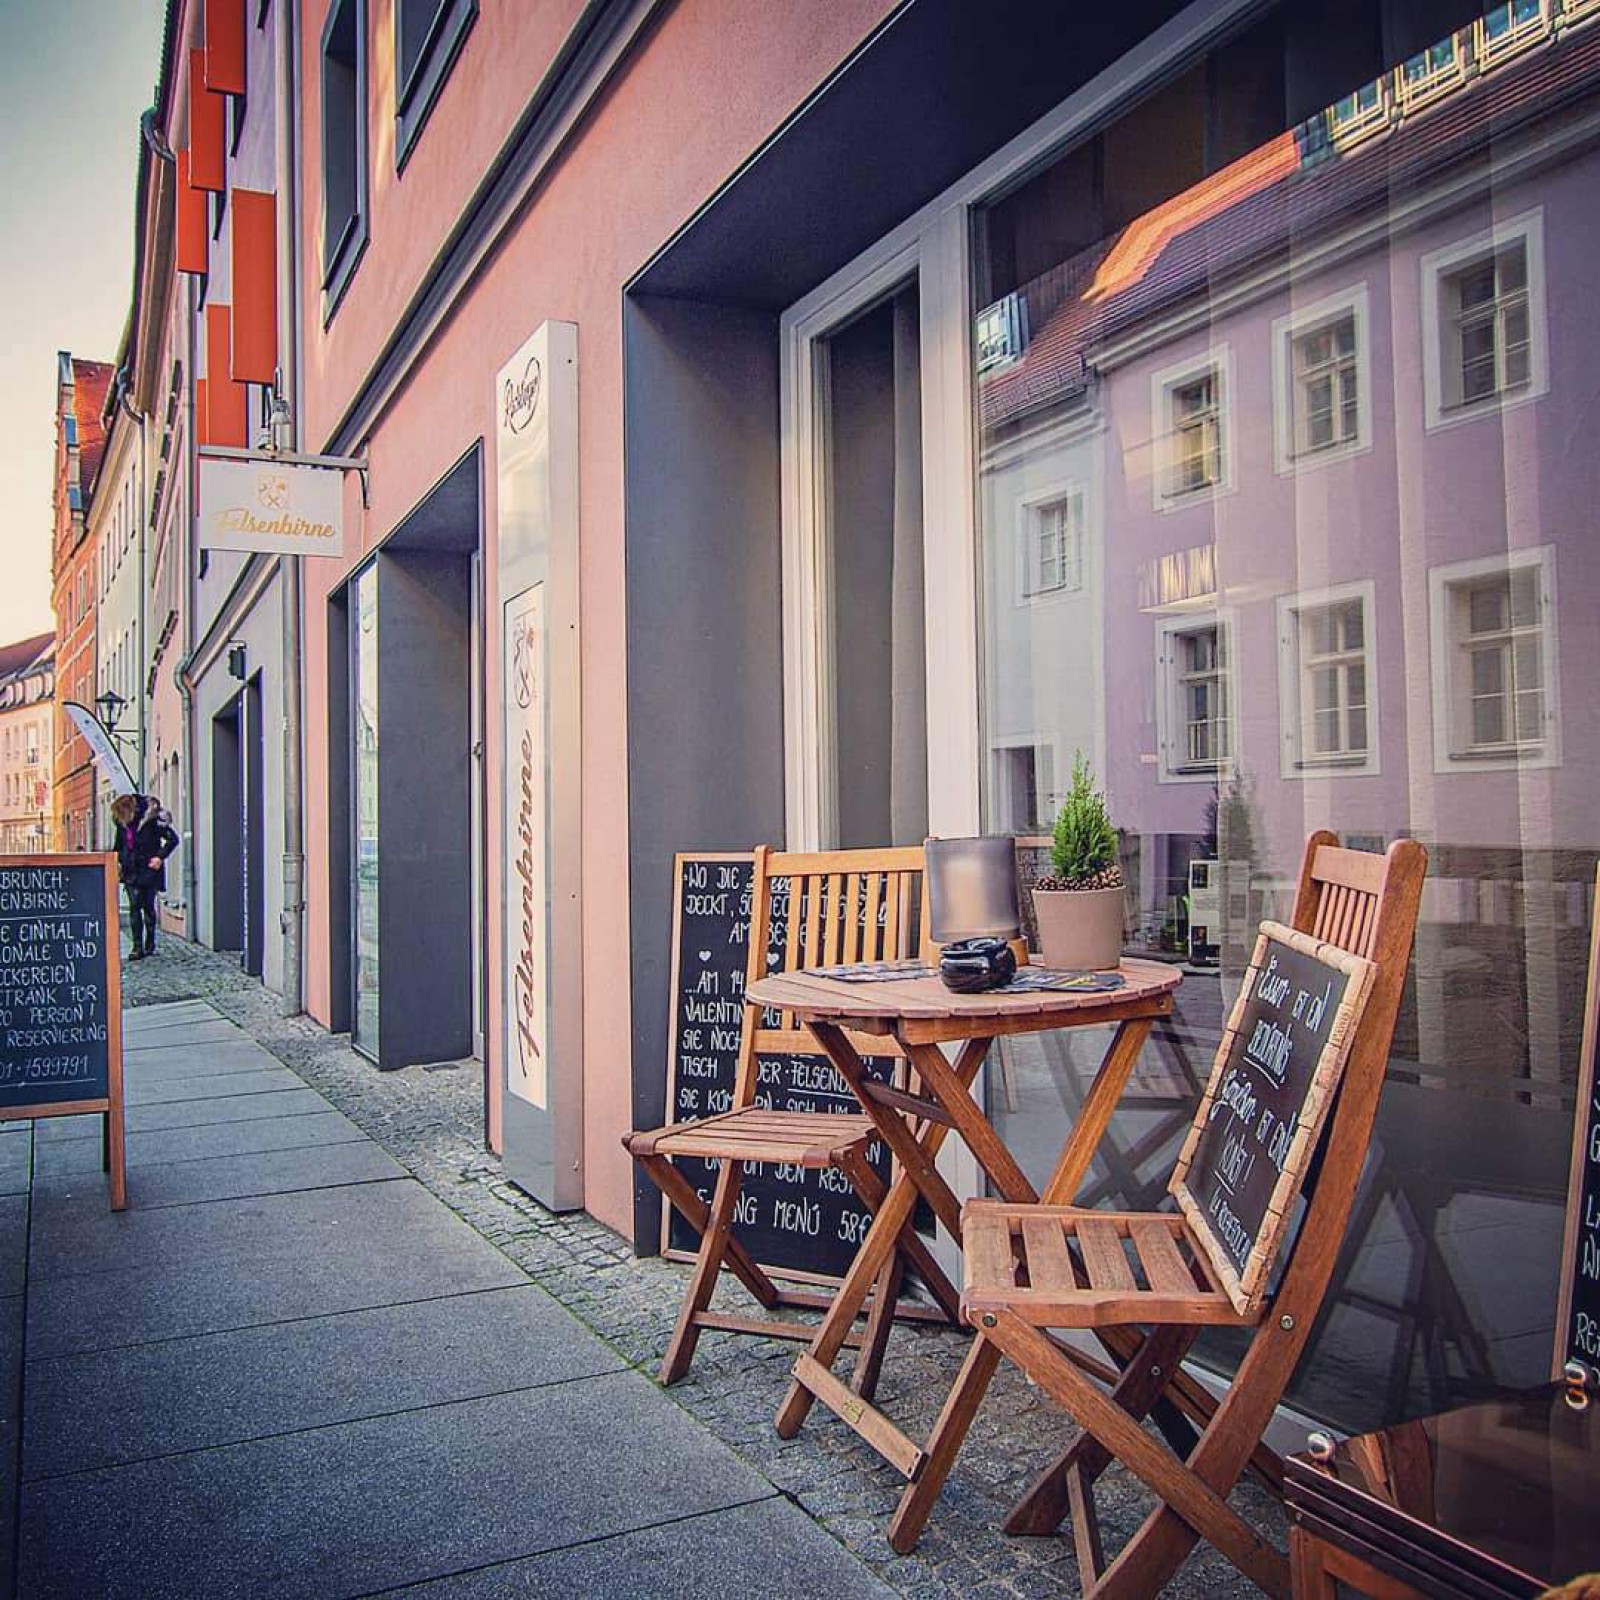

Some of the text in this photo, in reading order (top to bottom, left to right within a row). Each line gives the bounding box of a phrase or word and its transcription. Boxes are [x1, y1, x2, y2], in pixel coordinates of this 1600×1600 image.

[209, 507, 336, 543] Felsenbirne
[0, 869, 62, 890] BRUNCH
[717, 866, 740, 889] DIE
[514, 729, 540, 1078] Felsenbirne
[20, 919, 75, 942] EINMAL
[83, 919, 100, 937] IM
[0, 940, 97, 963] ONALE UND
[0, 986, 57, 1007] TRANK
[6, 1022, 106, 1048] RESERVIERUNG
[683, 1029, 703, 1050] SIE
[681, 1055, 717, 1079] TISCH
[680, 1088, 699, 1109] SIE
